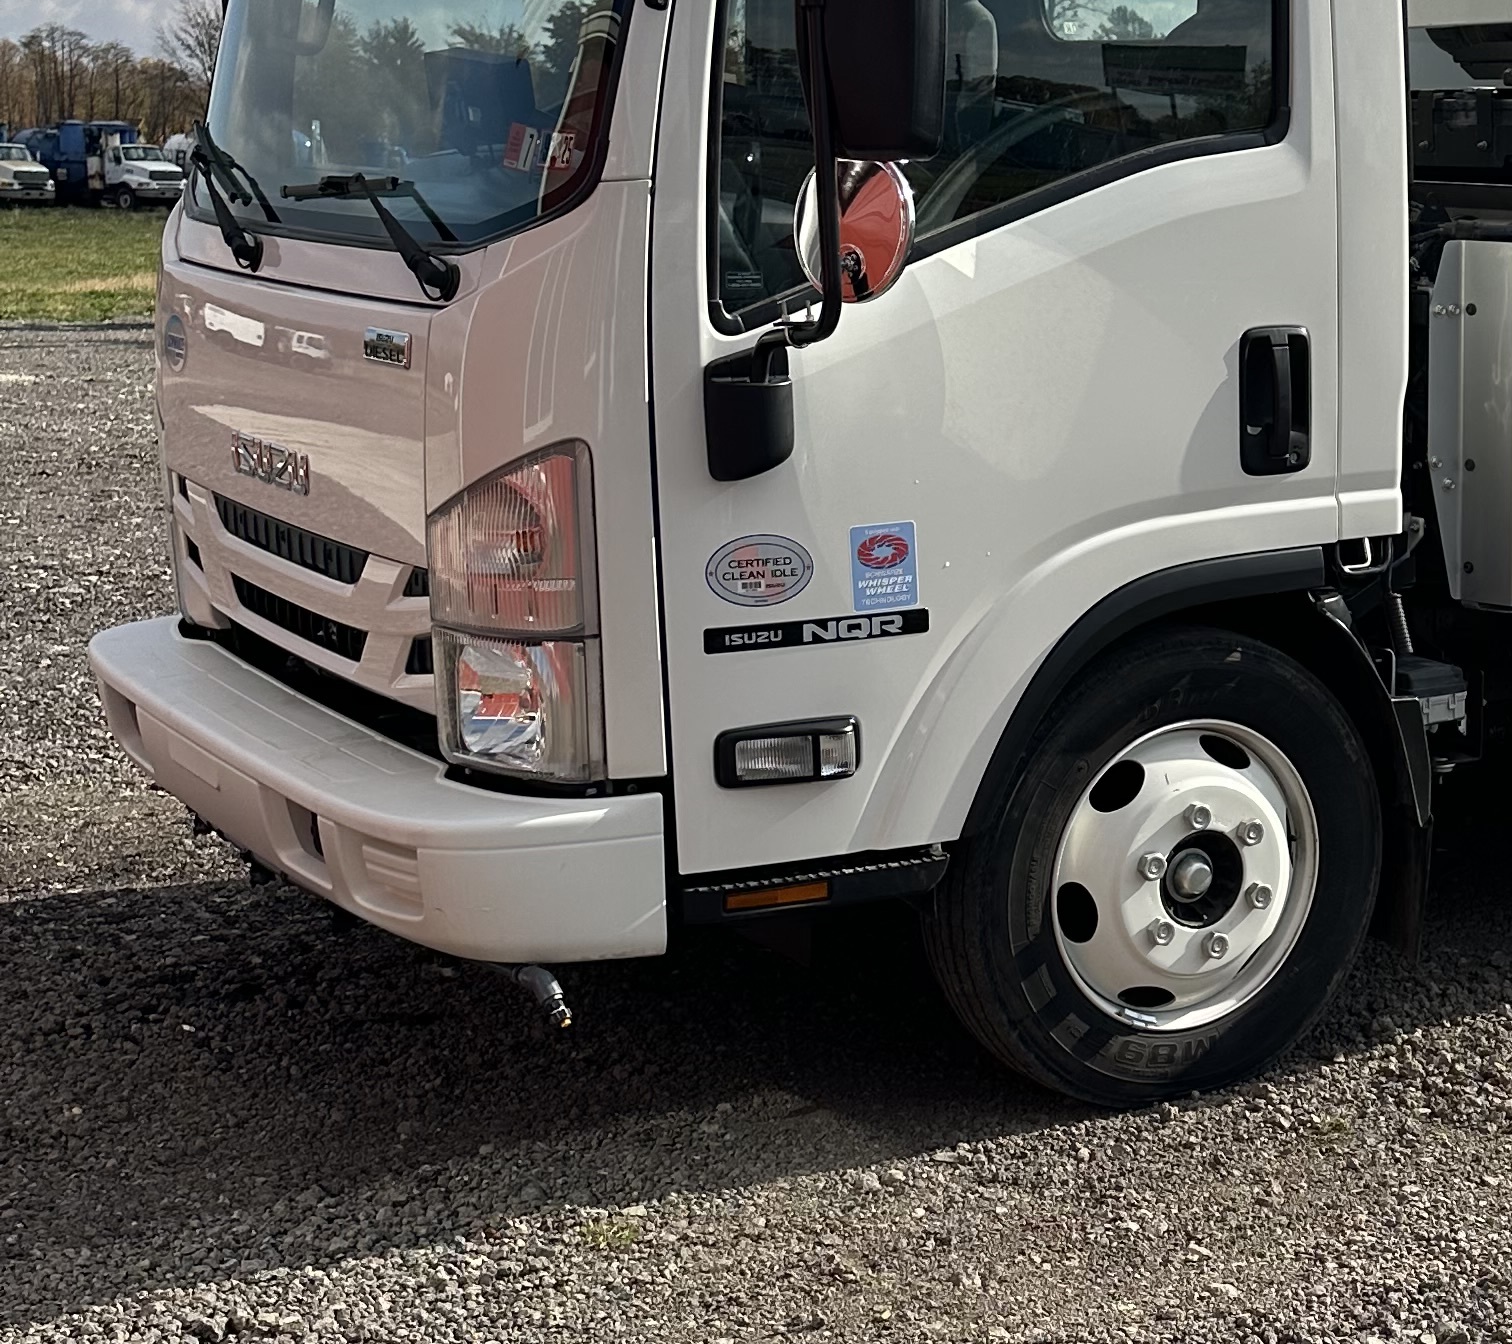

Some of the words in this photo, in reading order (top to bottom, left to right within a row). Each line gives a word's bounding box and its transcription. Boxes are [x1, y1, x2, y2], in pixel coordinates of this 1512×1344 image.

[364, 340, 405, 363] DIESEL
[231, 431, 310, 496] ISUZU
[728, 556, 792, 569] CERTIFIED
[722, 570, 765, 581] CLEAN
[771, 568, 799, 578] IDLE
[858, 575, 913, 589] WHISPER
[865, 584, 909, 596] WHEEL
[725, 630, 783, 647] ISUZU
[802, 614, 904, 643] NQR
